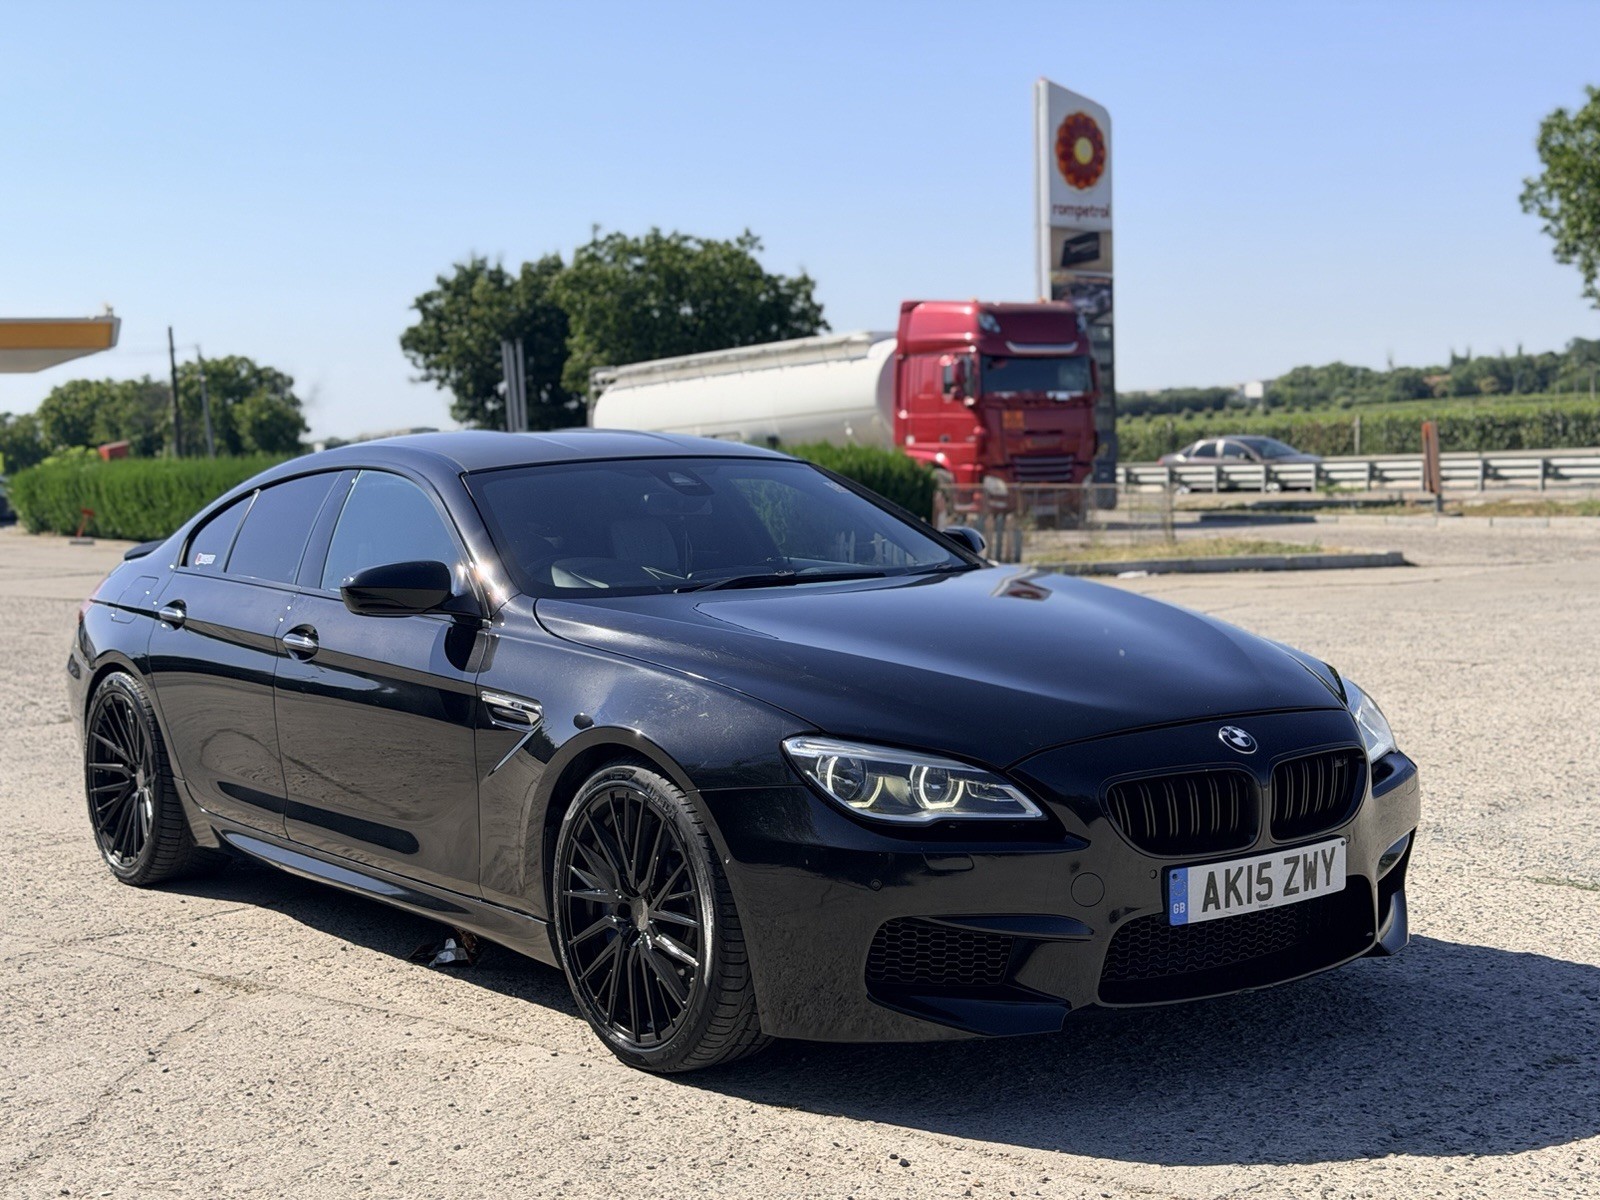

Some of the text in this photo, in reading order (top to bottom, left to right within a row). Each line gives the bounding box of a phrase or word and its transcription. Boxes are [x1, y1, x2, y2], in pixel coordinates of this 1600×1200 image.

[1201, 846, 1336, 913] AK15 ZWY
[1173, 902, 1186, 914] GB
